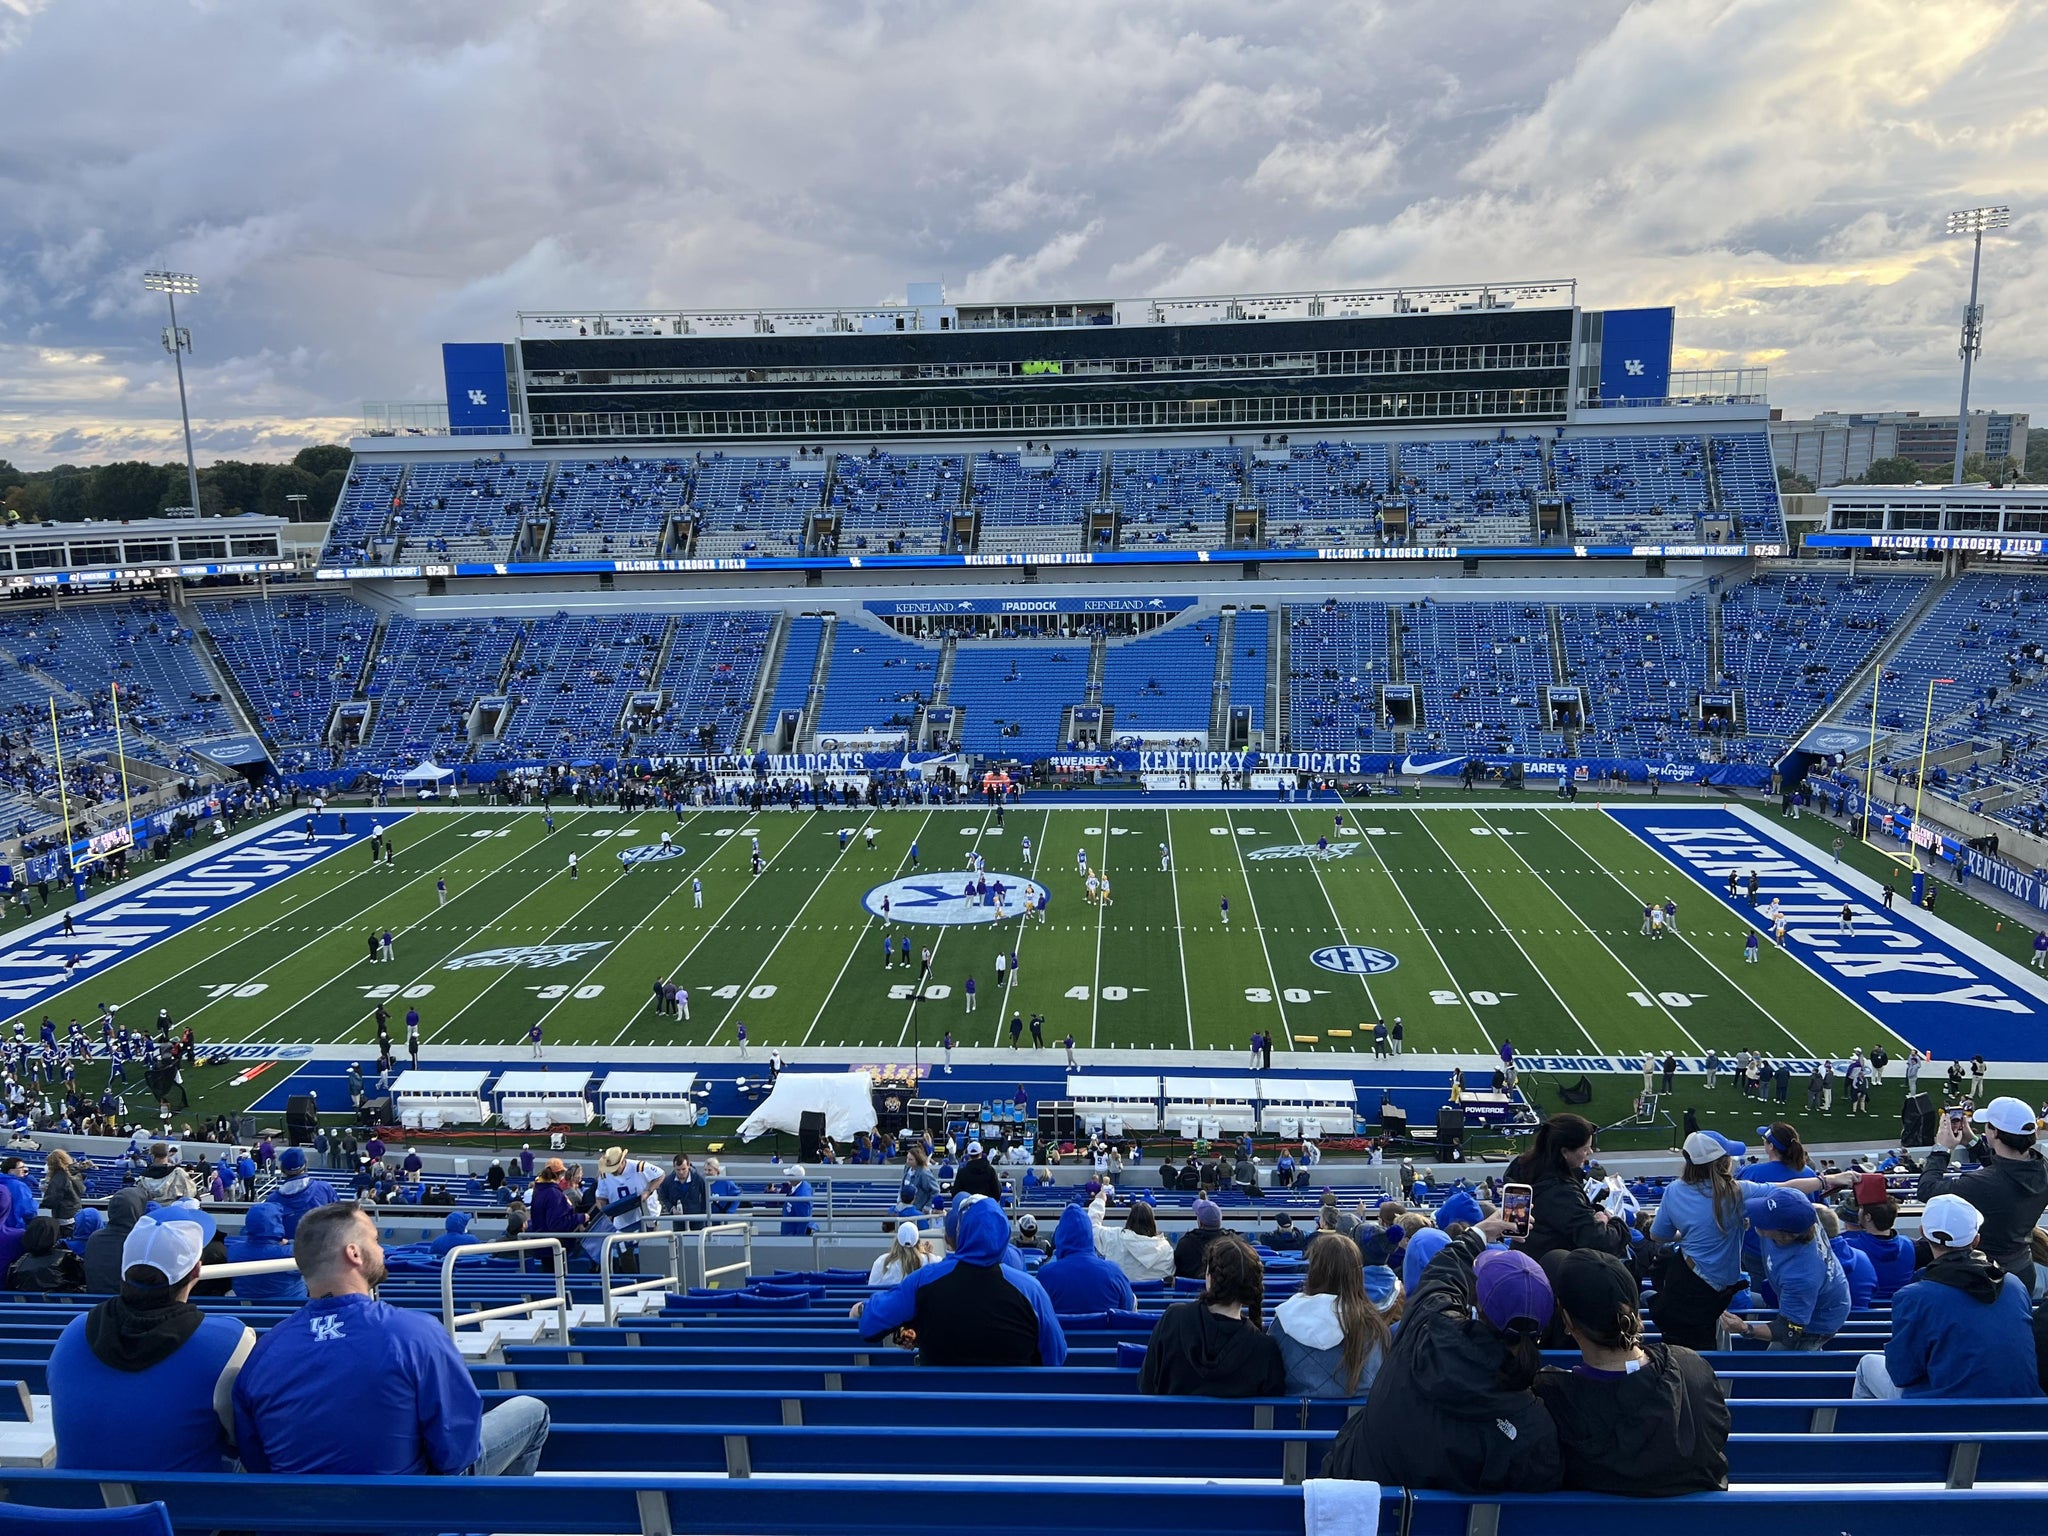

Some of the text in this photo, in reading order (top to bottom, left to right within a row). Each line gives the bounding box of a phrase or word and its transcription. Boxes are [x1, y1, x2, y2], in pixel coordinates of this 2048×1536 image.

[1624, 359, 1645, 376] UK
[467, 389, 488, 405] UK
[1664, 546, 1706, 556] COUNTDOWN
[1707, 546, 1715, 556] TO
[1715, 546, 1744, 556] KICKOFF
[1754, 545, 1780, 556] 57:53
[1871, 536, 2042, 552] WELCOME TO KROGER FIELD
[964, 553, 1093, 565] WELCOME TO KROGER FIELD
[1318, 547, 1457, 559] WELCOME TO KROGER FIELD
[346, 567, 384, 577] COUNTDOWN
[384, 567, 393, 576] TO
[393, 566, 419, 576] KICKOFF
[426, 566, 449, 576] 57:53
[614, 559, 747, 571] WELCOME TO KROGER FIELD
[896, 602, 954, 613] KEENELAND
[1006, 601, 1057, 611] PADDOCK
[1084, 600, 1143, 610] KEENELAND
[768, 753, 864, 773] WILDCATS
[1139, 751, 1361, 774] KENTUCKY WILDCATS
[1661, 763, 1695, 781] Kroger
[1968, 850, 2033, 900] KENTUCKY
[1645, 827, 2036, 1013] KENTUCKY
[442, 950, 589, 971] Kroger
[1317, 947, 1391, 973] SEC
[207, 983, 269, 998] 10
[363, 984, 436, 999] 20
[537, 984, 606, 999] 30
[711, 984, 778, 999] 40
[887, 984, 952, 1000] 50
[1065, 985, 1129, 1000] 40
[1244, 987, 1312, 1002] 30
[1428, 989, 1502, 1006] 20
[1627, 991, 1694, 1007] 10
[1514, 1056, 1614, 1072] BUREAU
[1465, 1106, 1505, 1114] POWERADE
[310, 1313, 347, 1342] UK
